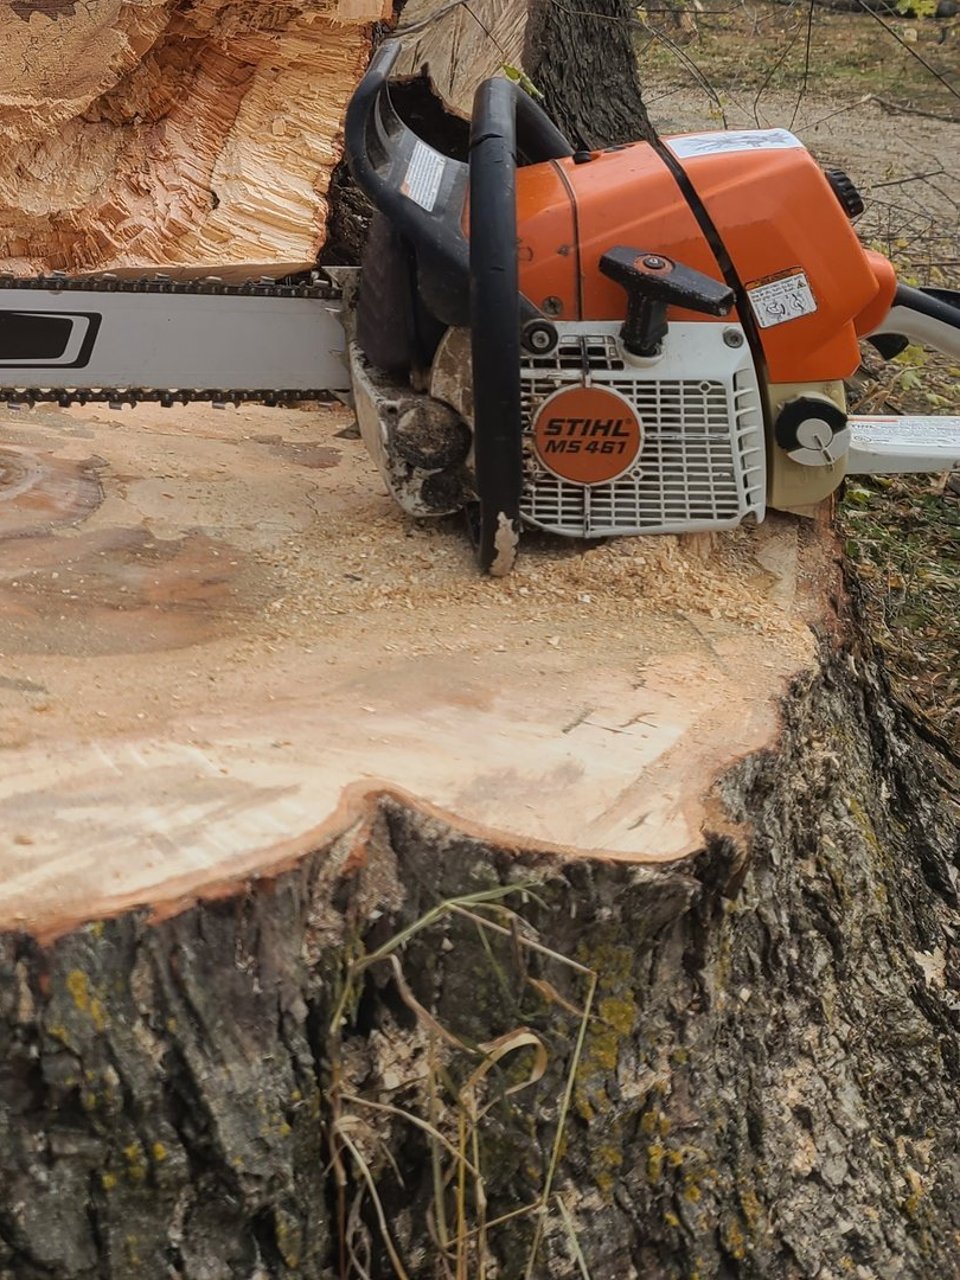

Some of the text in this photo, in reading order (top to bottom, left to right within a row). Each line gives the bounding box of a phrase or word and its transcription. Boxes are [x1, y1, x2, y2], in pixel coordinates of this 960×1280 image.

[543, 418, 630, 437] STIHL
[545, 440, 627, 455] MS 461
